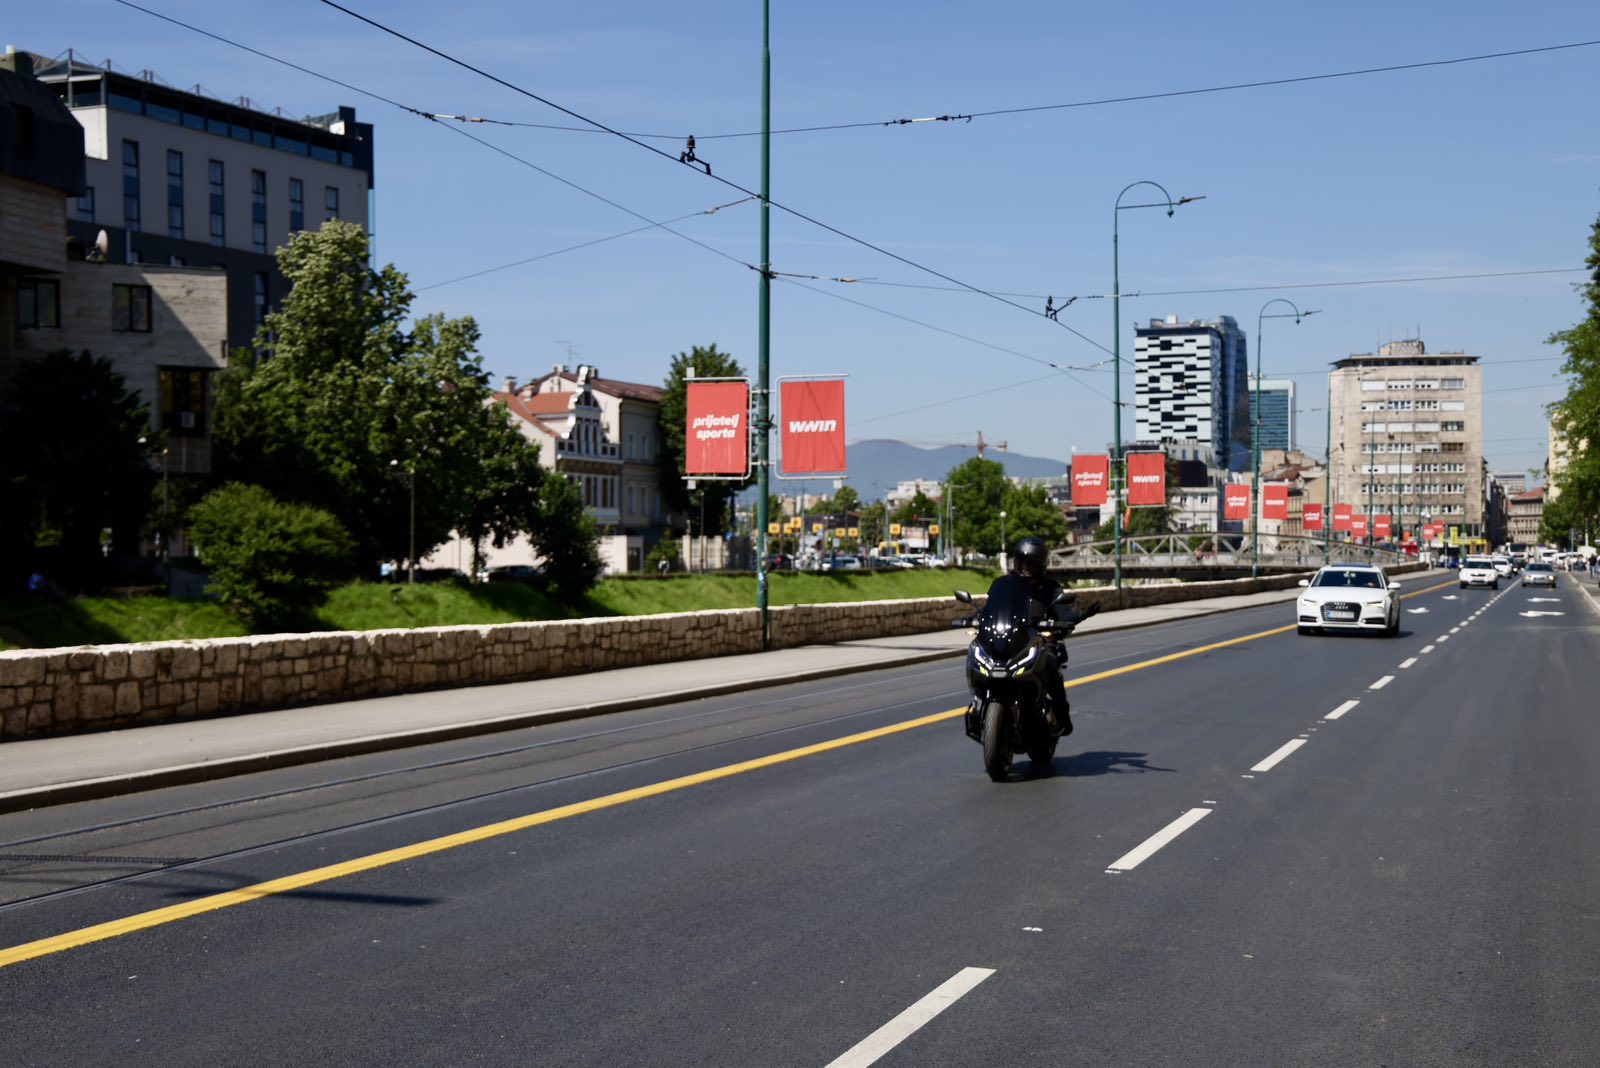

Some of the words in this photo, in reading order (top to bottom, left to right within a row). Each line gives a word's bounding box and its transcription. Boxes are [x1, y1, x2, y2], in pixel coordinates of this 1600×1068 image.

[693, 413, 740, 429] prijatelj
[696, 427, 736, 441] sporta
[1075, 472, 1104, 480] prijatelj
[1077, 479, 1102, 487] sporta
